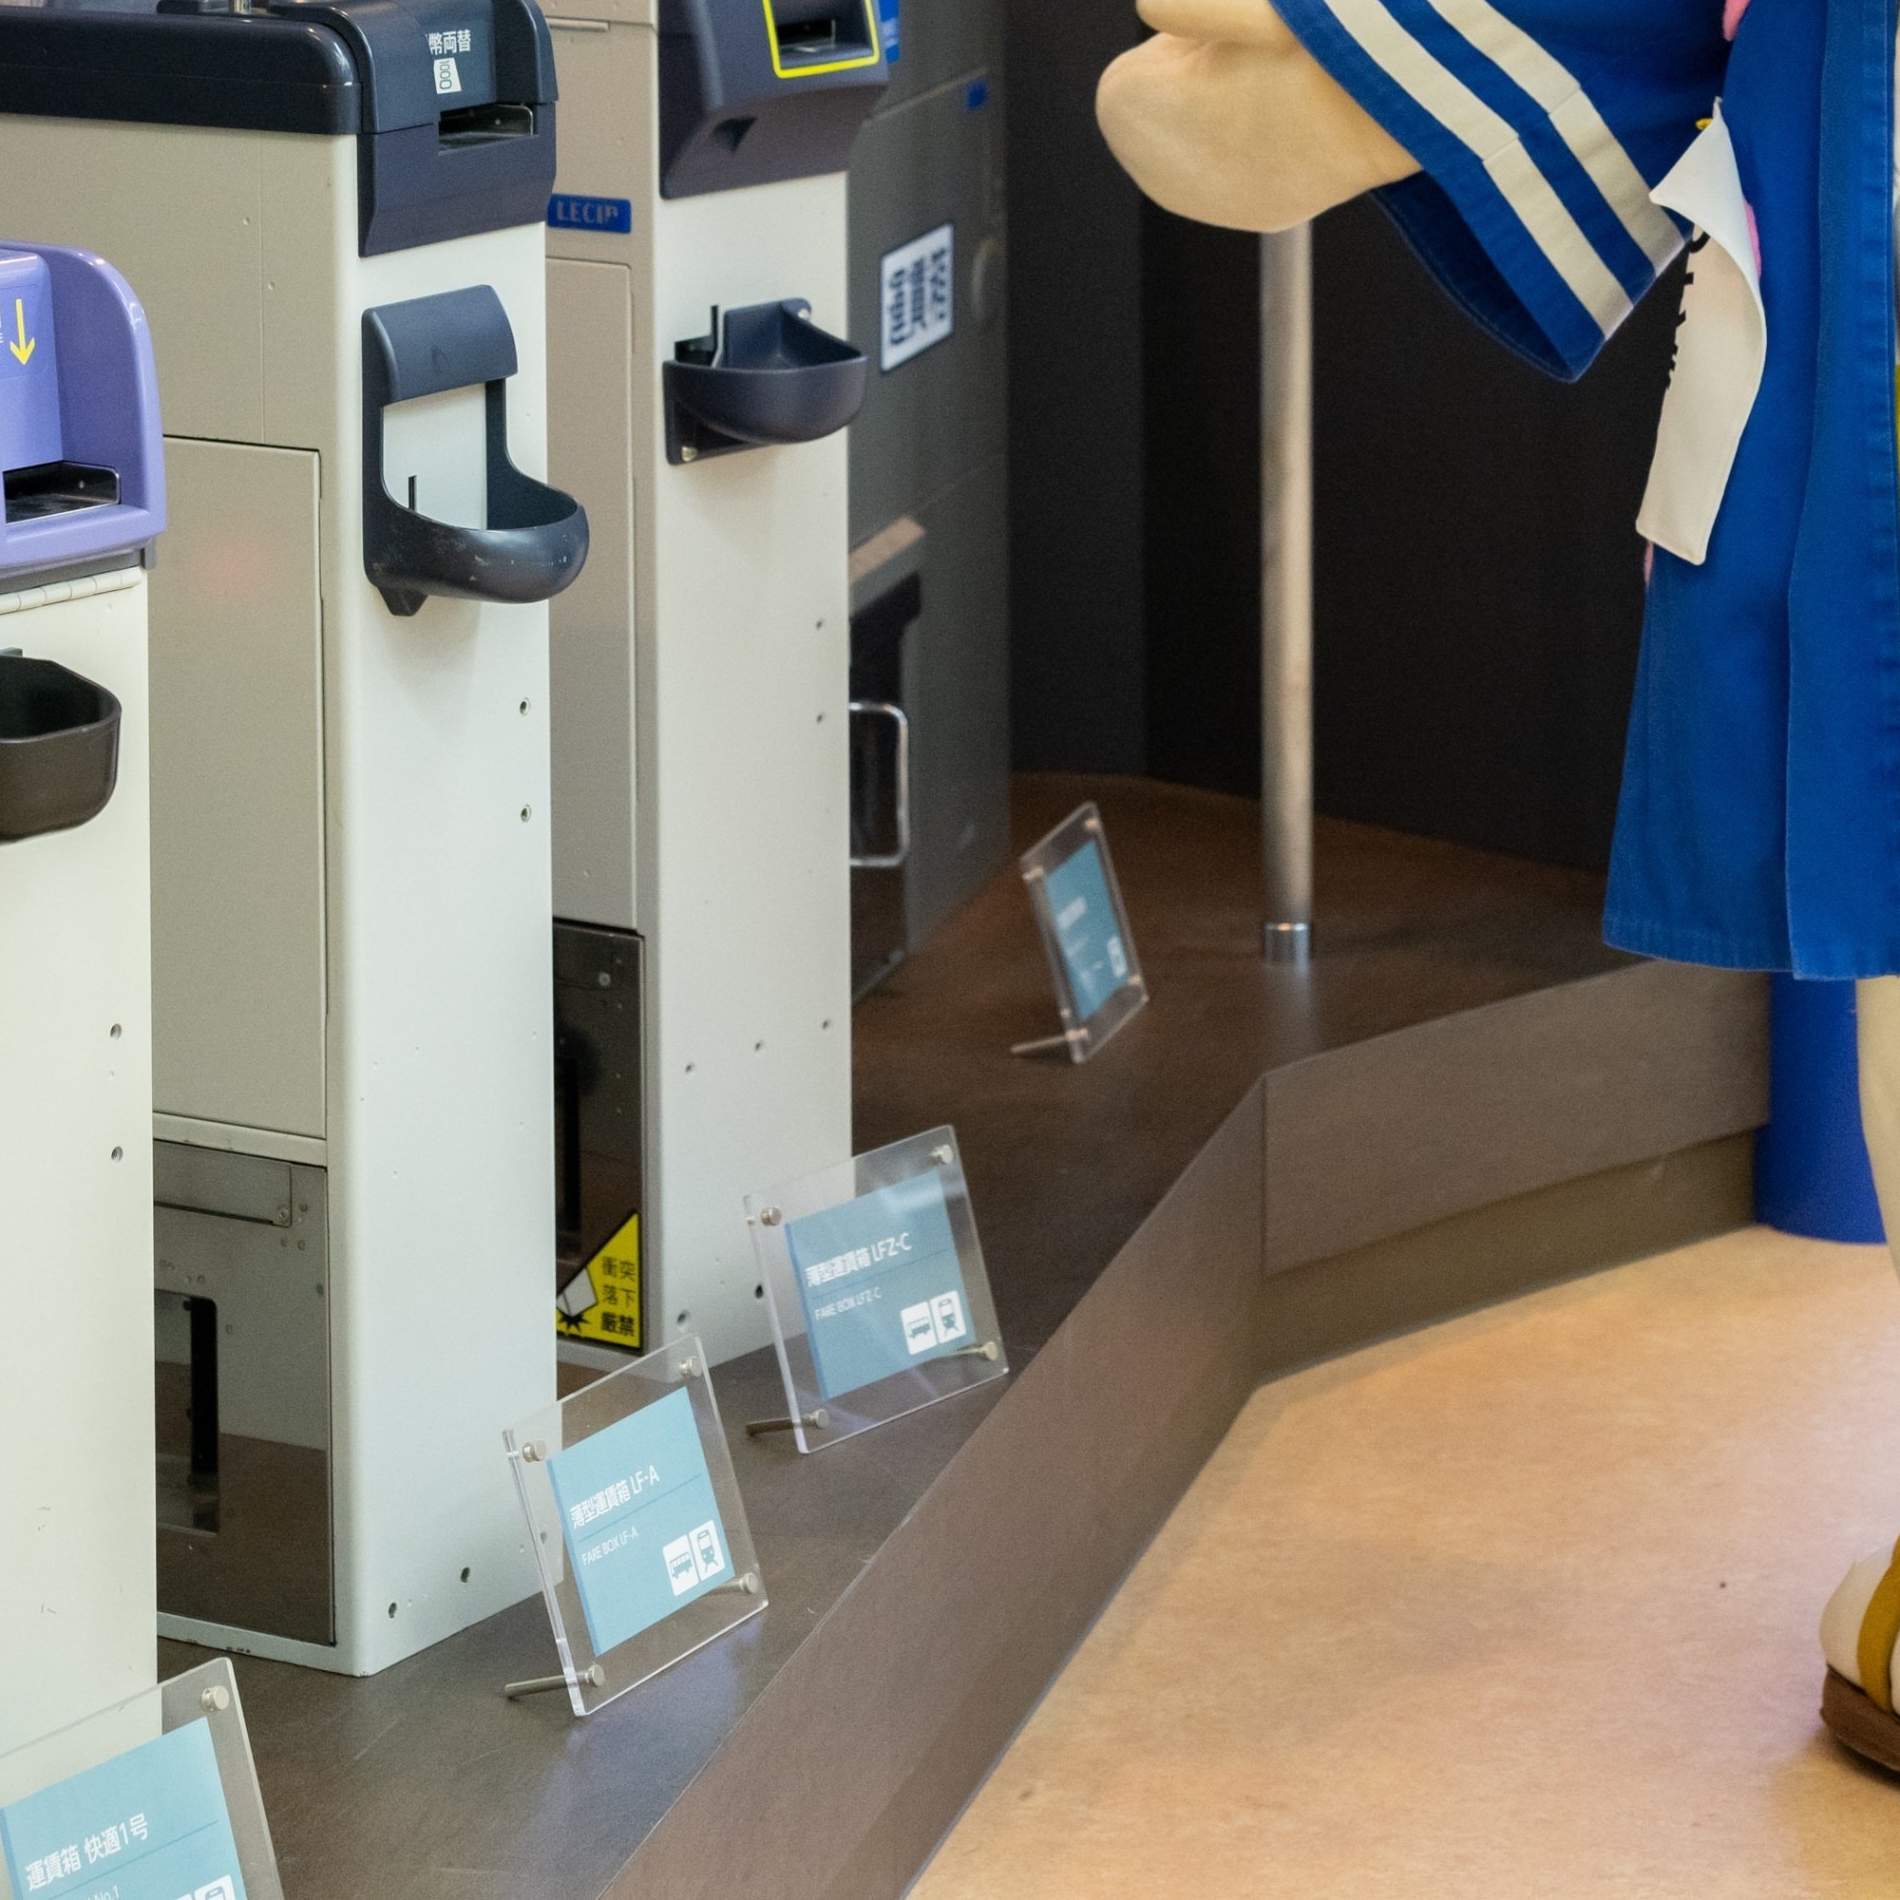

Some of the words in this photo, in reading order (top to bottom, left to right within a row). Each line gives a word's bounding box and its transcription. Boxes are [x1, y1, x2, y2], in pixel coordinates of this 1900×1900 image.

[425, 29, 471, 56] 幣両替
[871, 1232, 912, 1262] LFZ-C
[569, 1478, 631, 1530] 薄型運賃箱
[630, 1464, 660, 1496] LF-A
[581, 1545, 602, 1566] FARE
[602, 1536, 620, 1556] BOX
[619, 1526, 639, 1546] LF-A
[25, 1844, 82, 1892] 運賃箱
[84, 1812, 149, 1865] 快適1号
